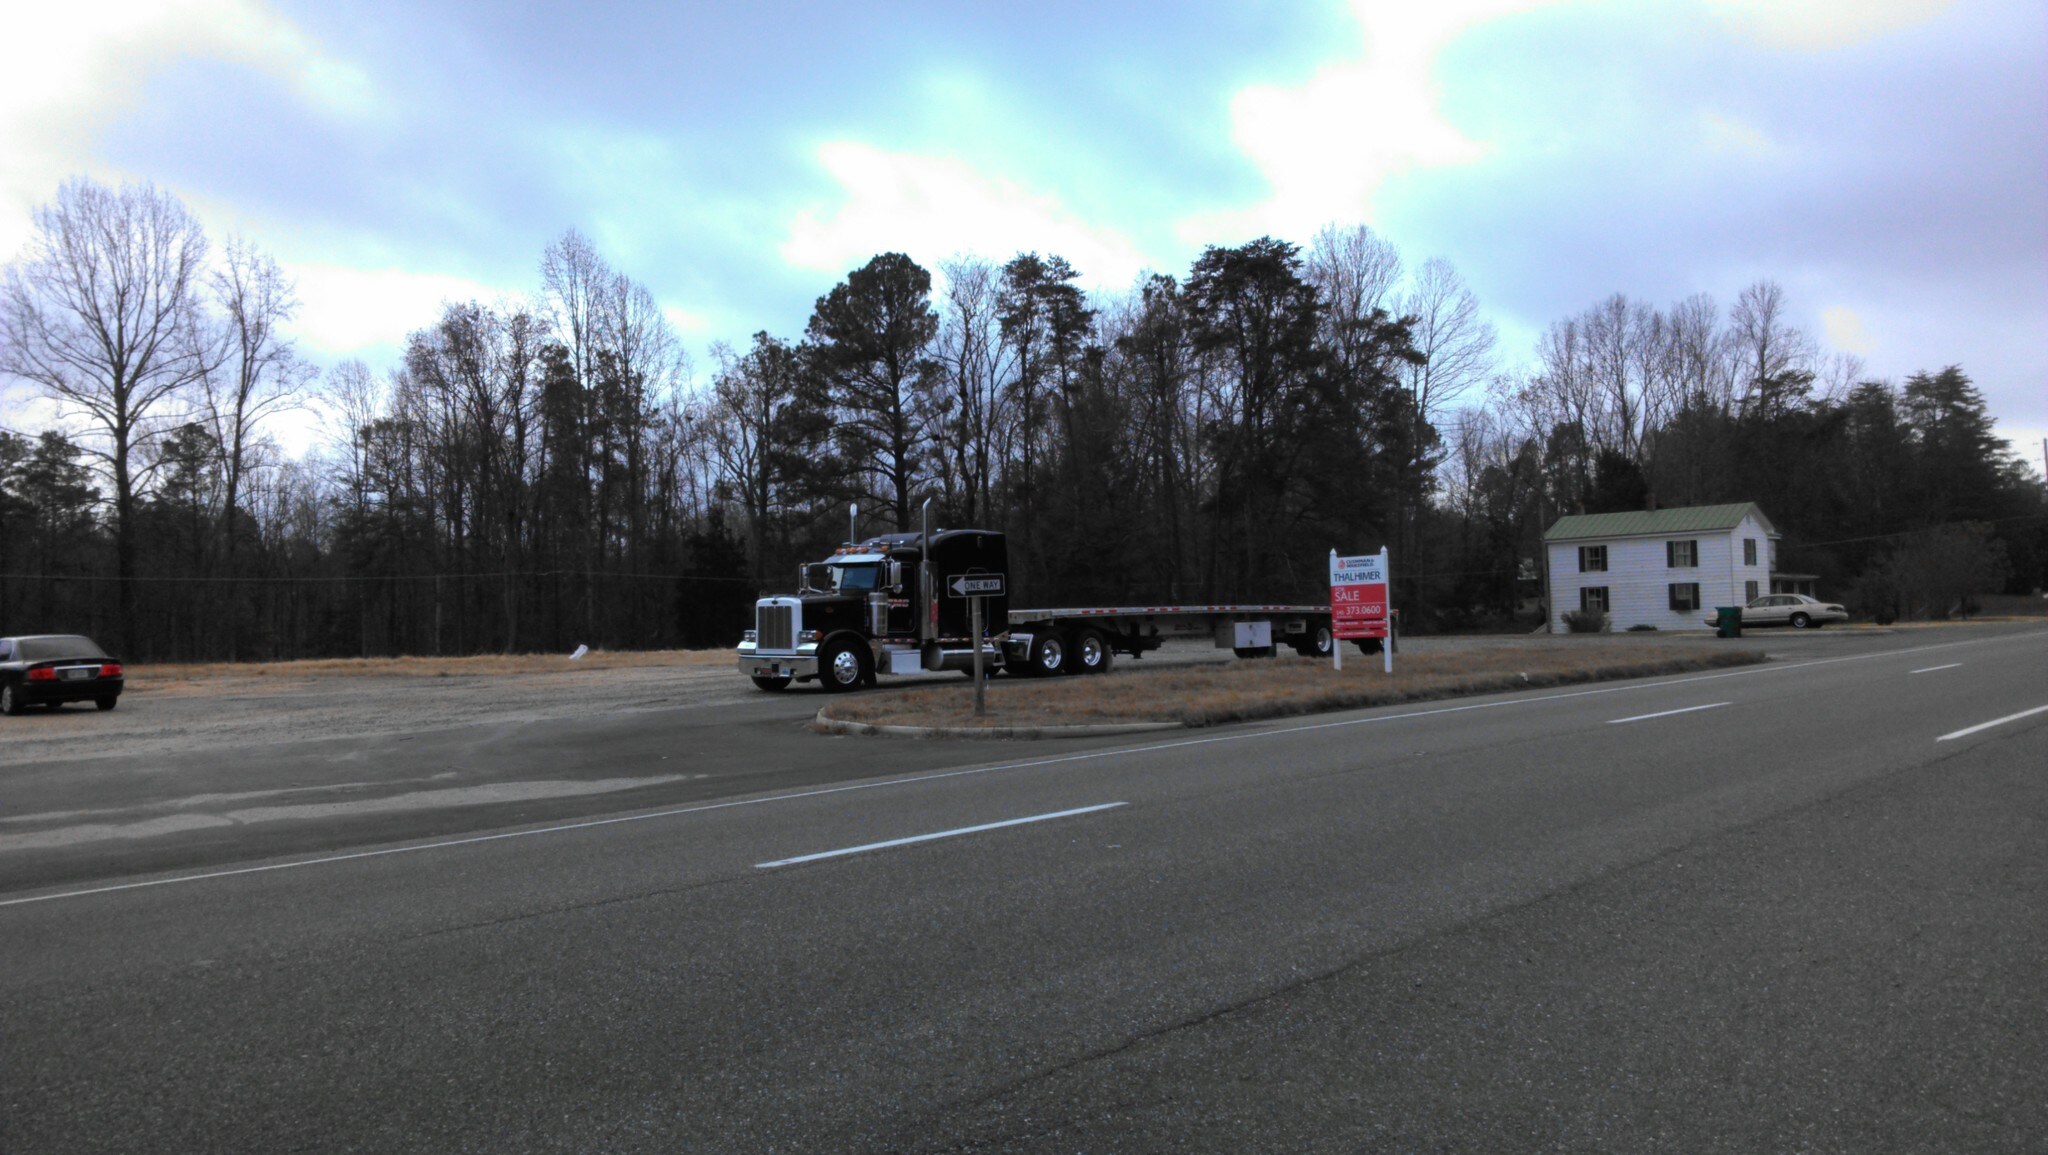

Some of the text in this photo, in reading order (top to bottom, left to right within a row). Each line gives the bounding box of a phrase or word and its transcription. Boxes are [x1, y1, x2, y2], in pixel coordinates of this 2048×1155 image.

[1334, 571, 1380, 582] THALHIMER
[965, 580, 998, 590] ONE WAY
[1335, 591, 1359, 601] SALE
[1346, 605, 1380, 615] 373.0600
